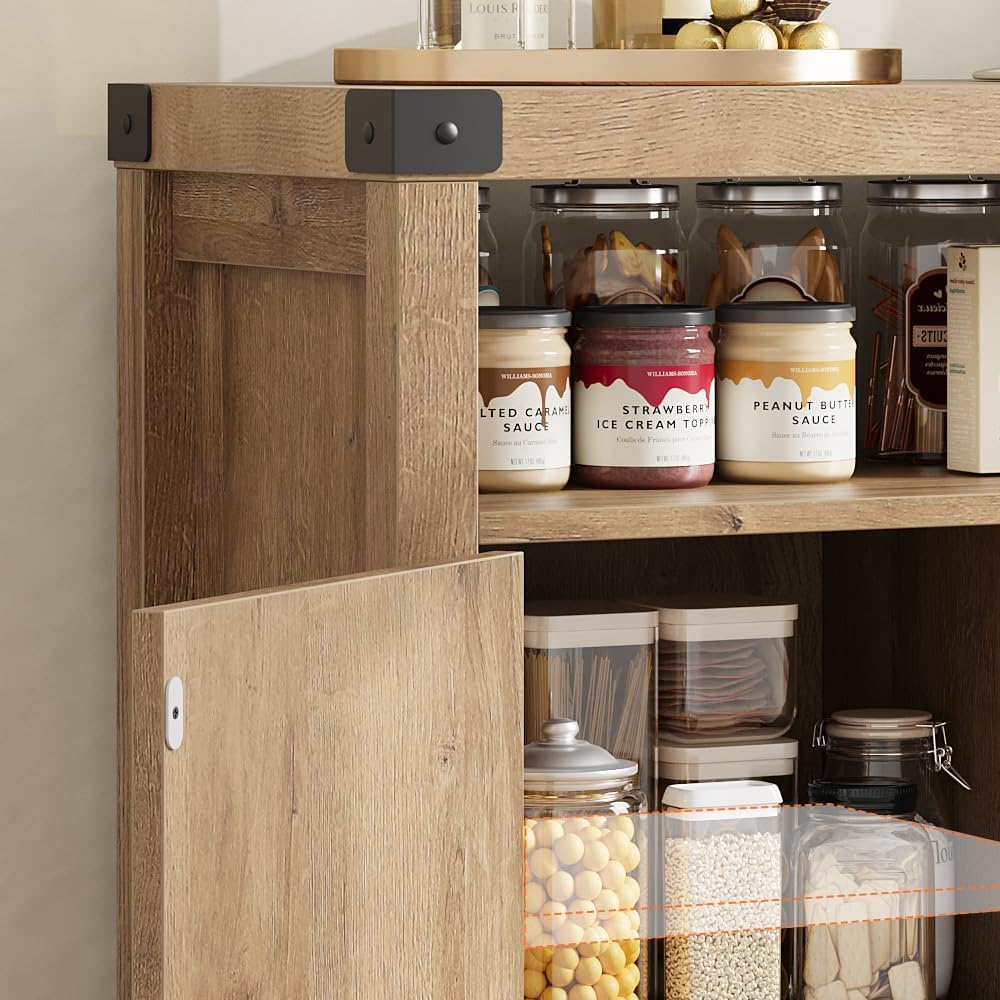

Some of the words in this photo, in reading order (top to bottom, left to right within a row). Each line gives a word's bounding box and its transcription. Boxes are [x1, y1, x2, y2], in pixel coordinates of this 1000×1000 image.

[469, 2, 508, 14] LOUIS
[480, 408, 517, 418] LTED
[525, 405, 570, 418] CARAME
[753, 401, 814, 411] PEANUT
[597, 419, 618, 429] ICE
[625, 420, 676, 430] CREAM
[792, 415, 836, 425] SAUCE
[504, 422, 549, 433] SAUCE
